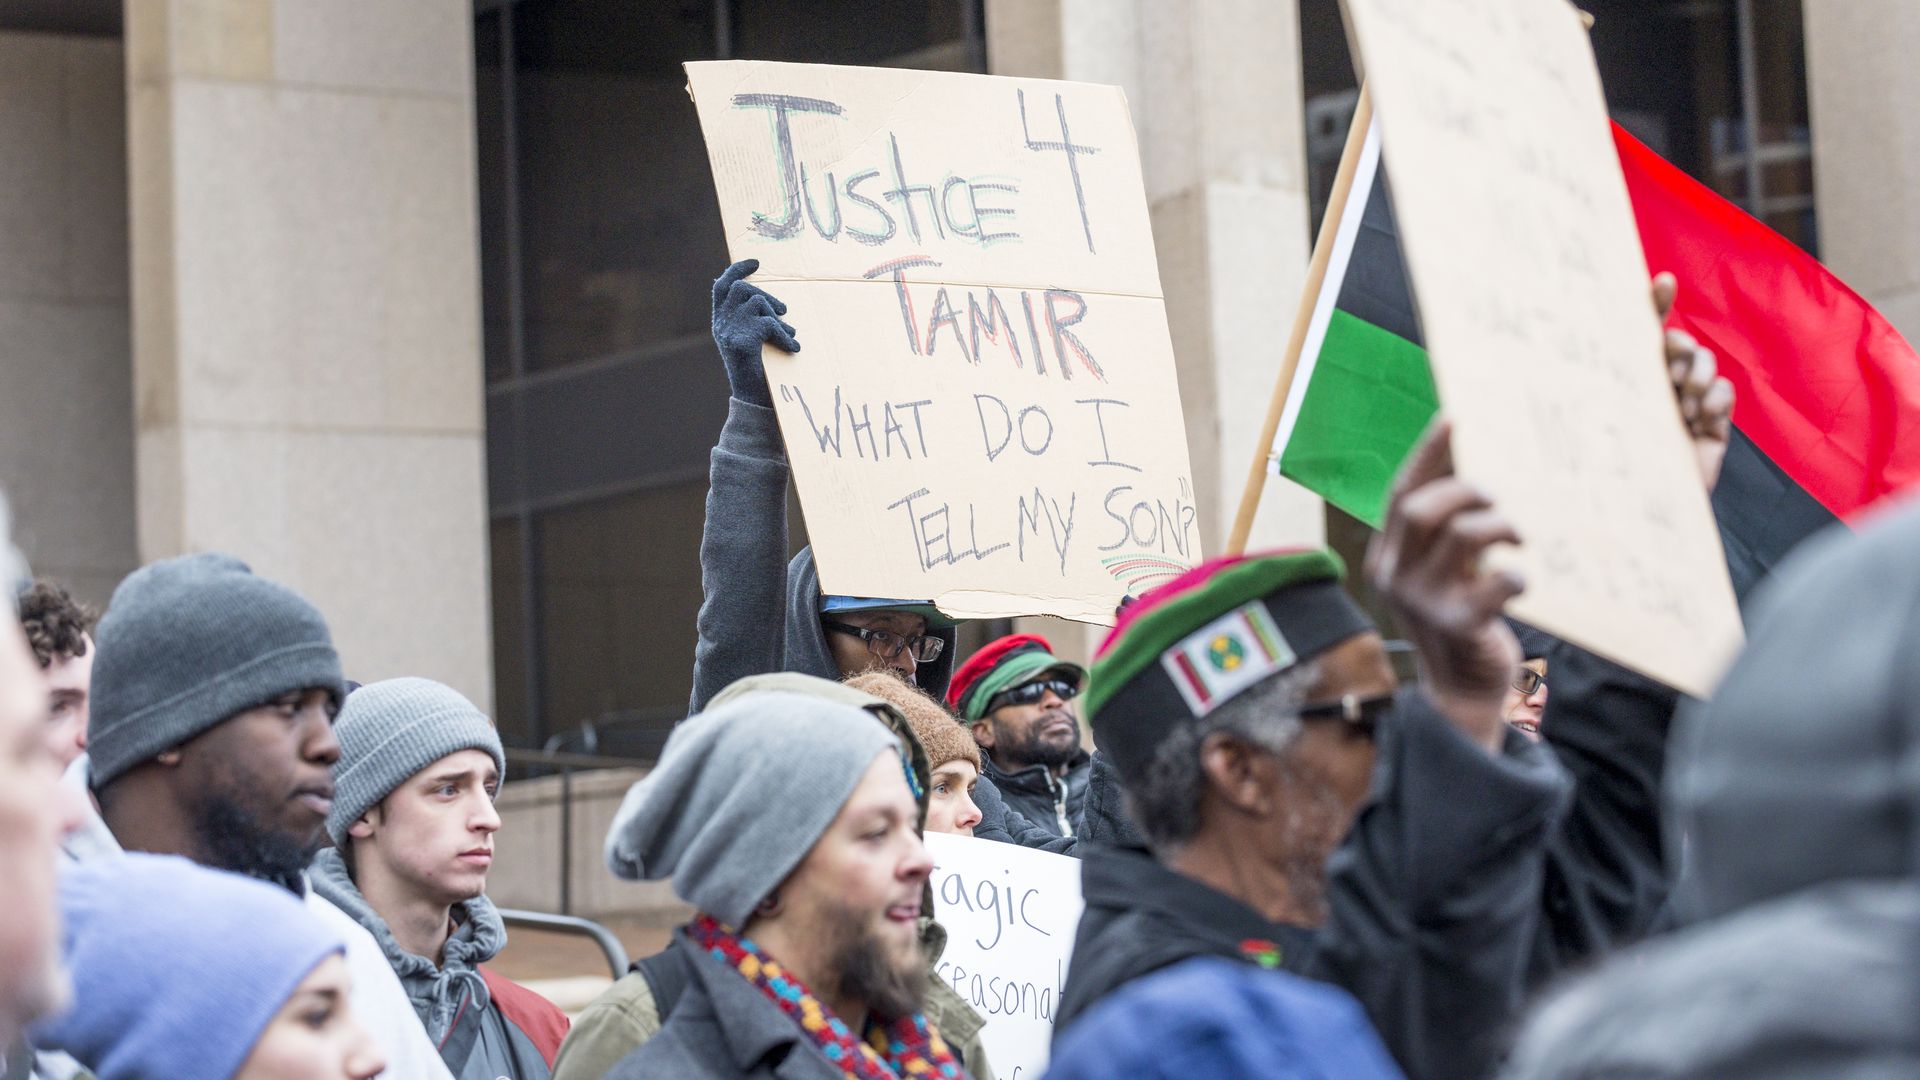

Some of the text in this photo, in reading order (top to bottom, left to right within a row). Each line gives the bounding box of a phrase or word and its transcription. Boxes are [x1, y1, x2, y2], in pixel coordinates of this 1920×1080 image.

[1018, 88, 1103, 256] 4
[862, 254, 1109, 384] TAMIR
[973, 393, 1054, 462] DO
[1074, 398, 1143, 472] I
[886, 487, 1011, 574] TELL
[1018, 486, 1077, 577] MY
[932, 864, 1051, 950] agic
